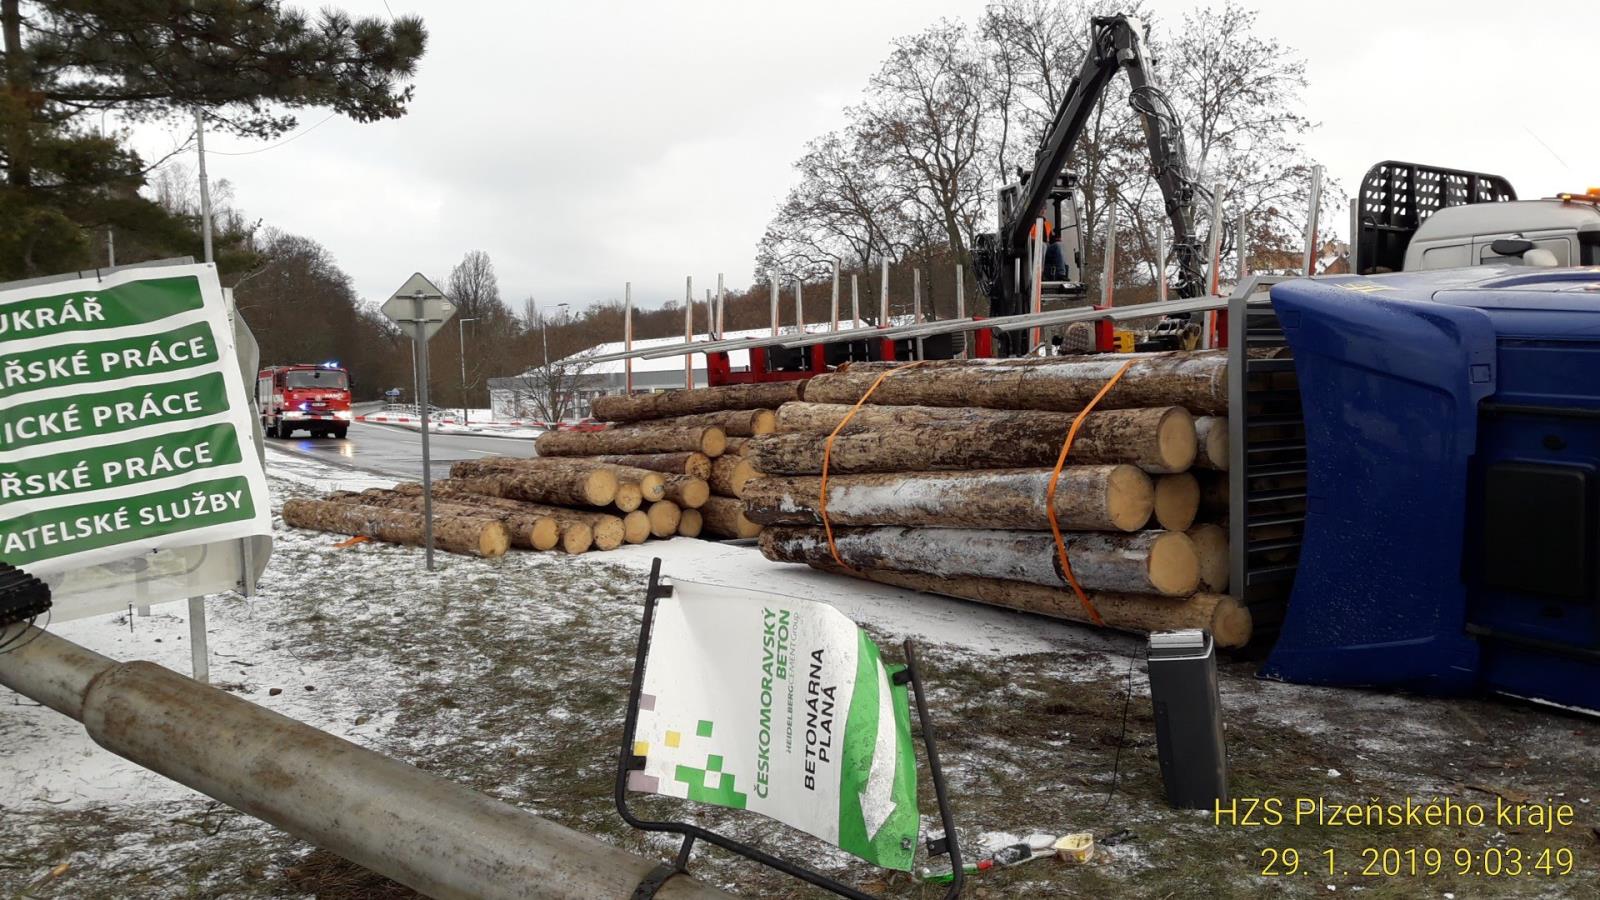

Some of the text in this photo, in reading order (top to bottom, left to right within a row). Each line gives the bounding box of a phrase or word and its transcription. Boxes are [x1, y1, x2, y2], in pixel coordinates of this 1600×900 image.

[0, 335, 208, 391] ŘSKÉ PRÁCE
[0, 391, 203, 445] ICKÉ PRÁCE
[103, 441, 213, 484] PRÁCE
[0, 489, 244, 555] ATELSKÉ SLUŽBY
[776, 608, 791, 681] BETON
[753, 607, 777, 800] ČESKOMORAVSKÝ
[804, 648, 825, 791] BETONÁRNA
[819, 685, 837, 763] PLANÁ
